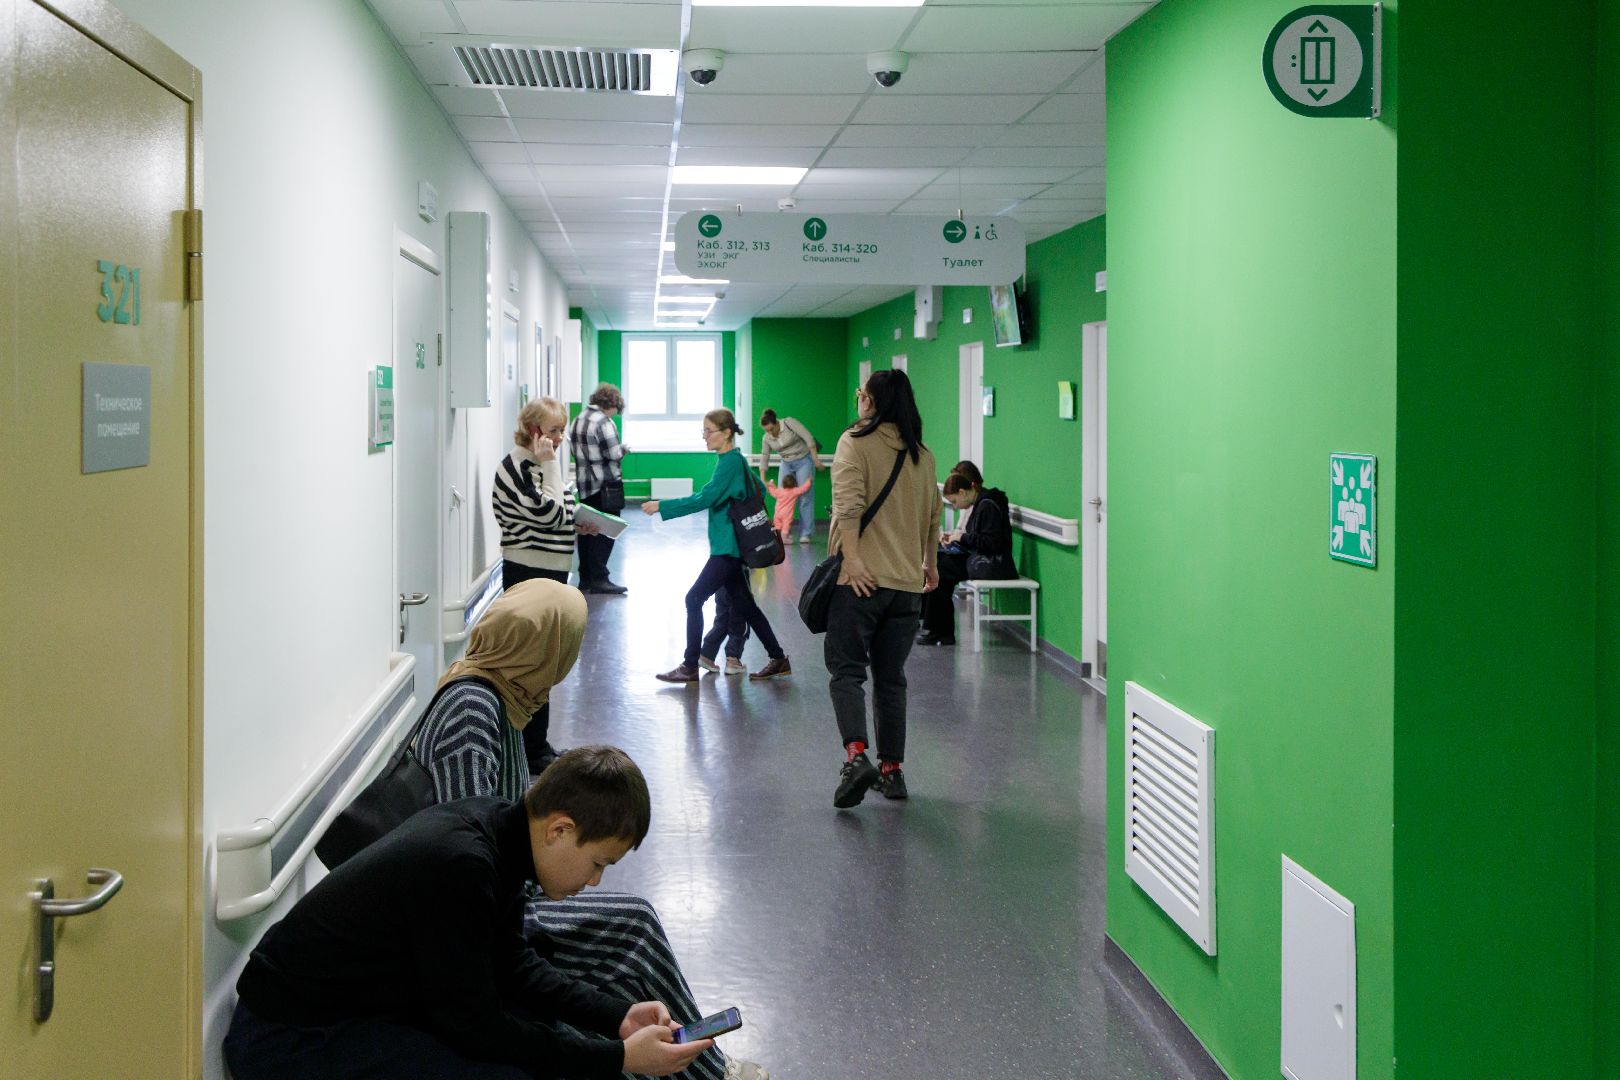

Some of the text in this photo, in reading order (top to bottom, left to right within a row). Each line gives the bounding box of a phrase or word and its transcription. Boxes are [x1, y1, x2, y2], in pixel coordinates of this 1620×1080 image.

[697, 239, 770, 252] Каб. 312, 313
[802, 242, 878, 254] Каб. 314-320
[697, 251, 740, 260] УЗИ ЭКГ
[802, 254, 860, 263] Специалисты
[697, 260, 728, 269] ЭХОКГ
[942, 257, 984, 269] Туалет
[96, 259, 141, 326] 321
[95, 393, 142, 412] Техническое
[97, 422, 140, 438] помещение
